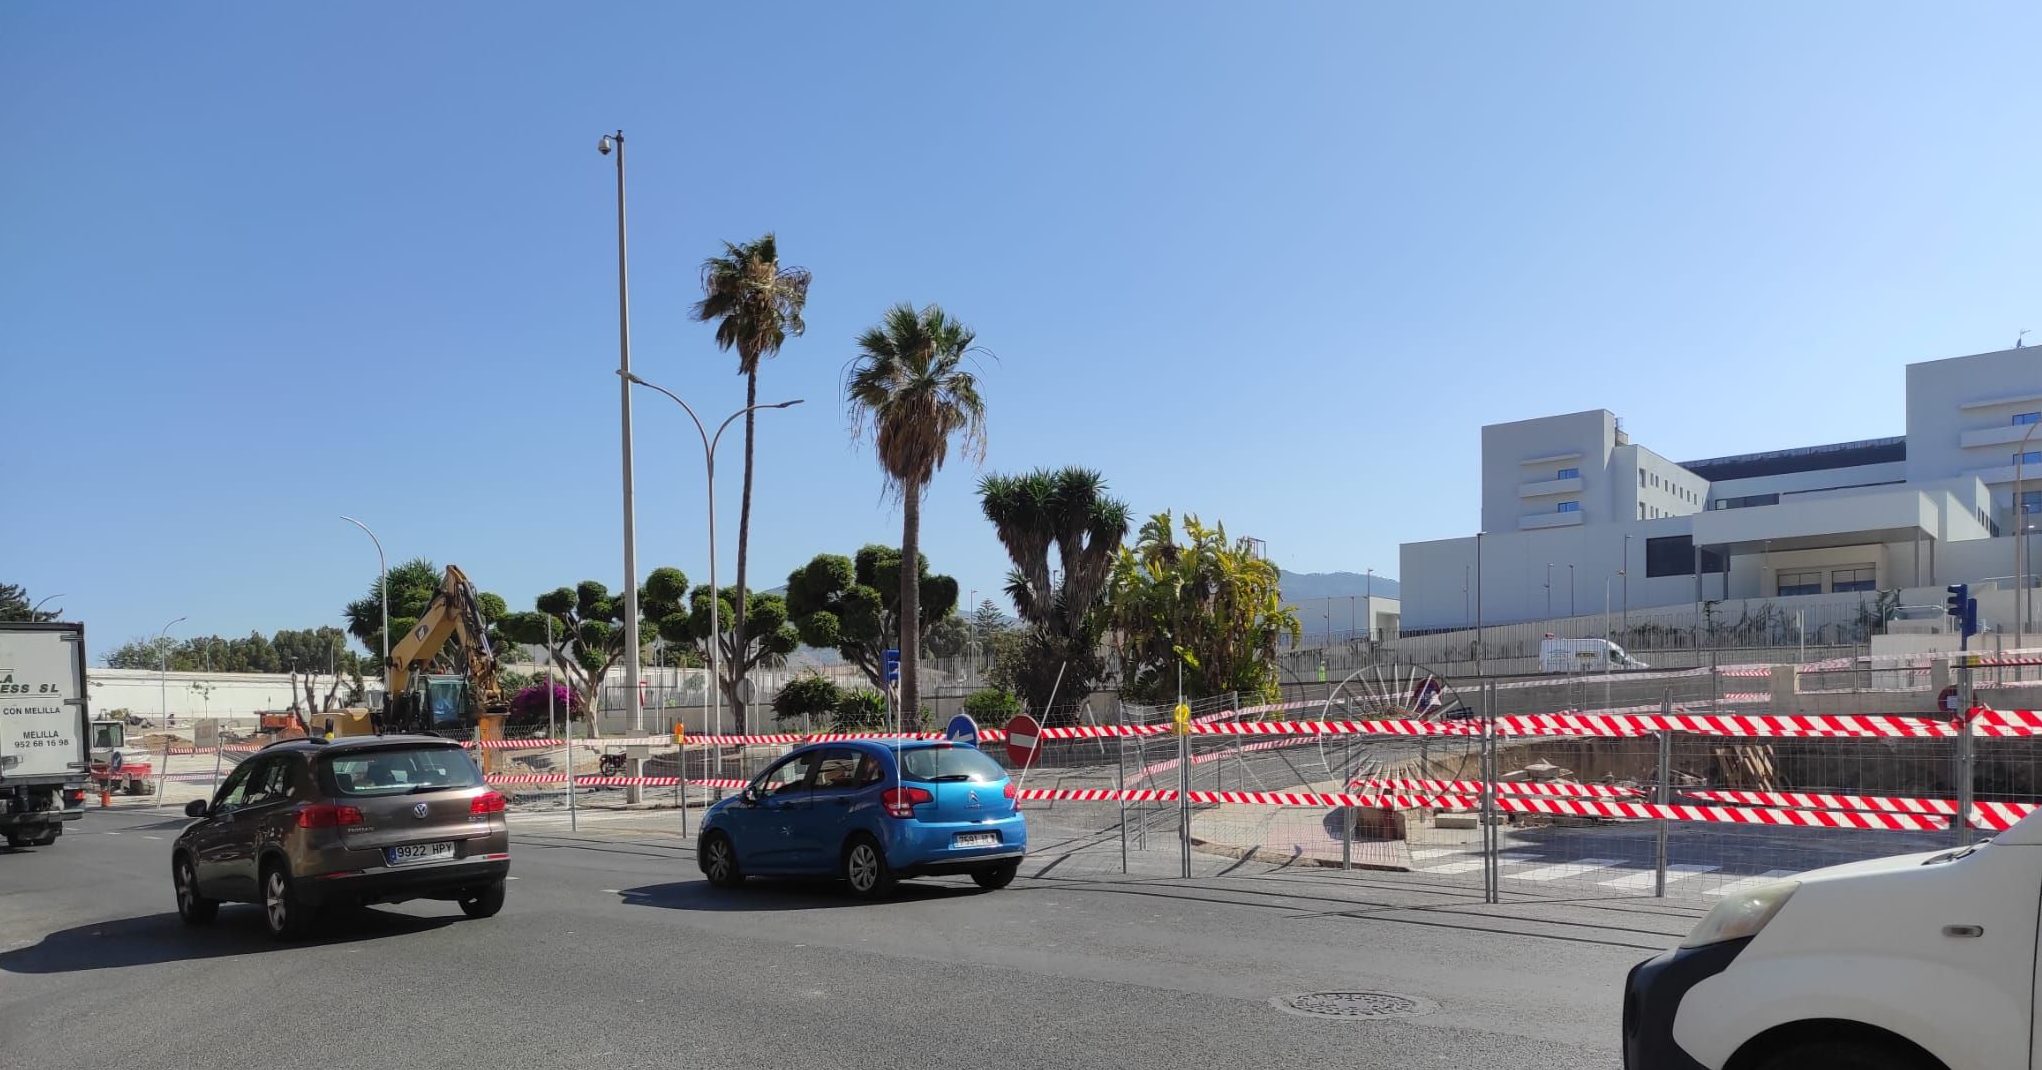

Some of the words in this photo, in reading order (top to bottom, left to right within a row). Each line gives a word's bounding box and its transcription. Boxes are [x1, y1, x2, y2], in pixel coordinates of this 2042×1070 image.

[0, 674, 13, 684] A
[39, 684, 59, 693] SL
[3, 707, 22, 715] CON
[24, 707, 61, 715] MELILLA
[23, 730, 59, 739] MELILLA
[397, 841, 426, 857] 9922
[432, 843, 452, 854] HPY
